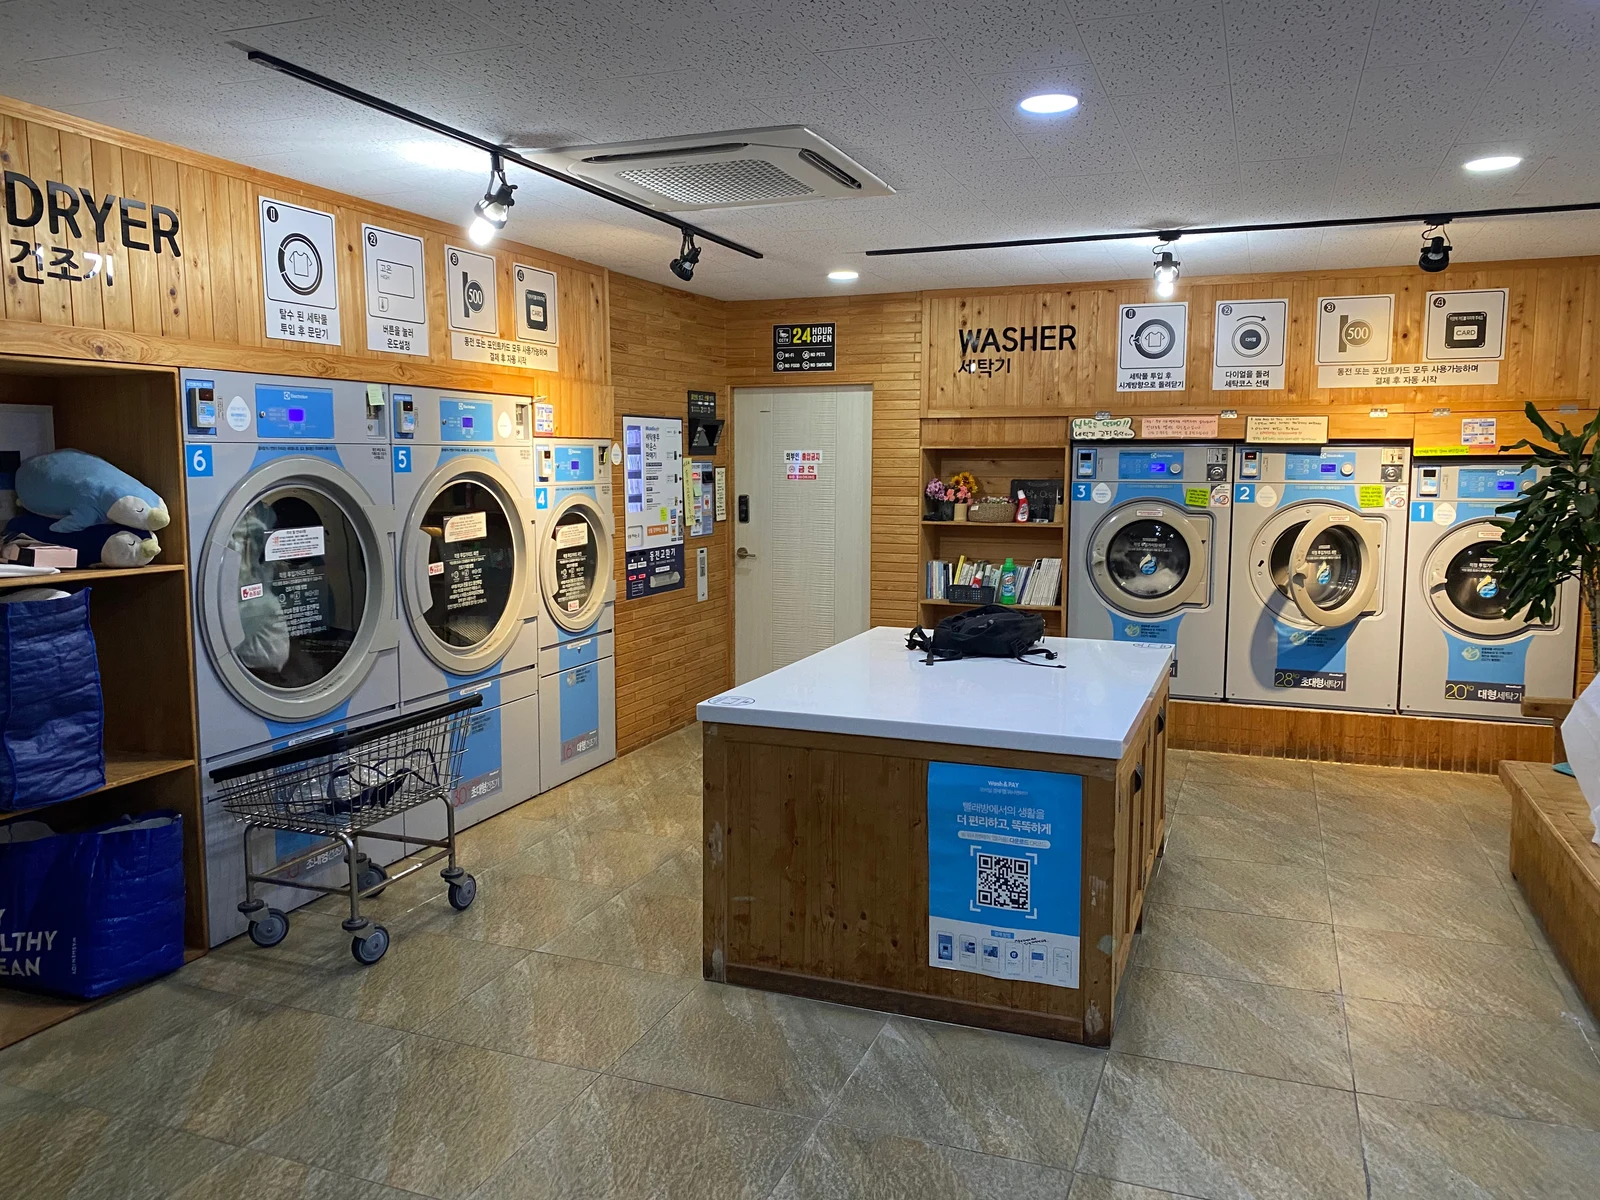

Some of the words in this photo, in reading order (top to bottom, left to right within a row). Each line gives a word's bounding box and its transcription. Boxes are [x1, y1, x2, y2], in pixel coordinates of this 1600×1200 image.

[4, 170, 181, 257] DRYER
[10, 239, 114, 287] 건조기
[468, 288, 483, 305] 500
[279, 308, 295, 322] 탈수
[296, 311, 304, 322] 된
[307, 313, 328, 326] 세탁물
[280, 323, 296, 336] 투입
[298, 325, 306, 336] 후
[308, 326, 329, 340] 문닫기
[382, 324, 400, 338] 버튼을
[792, 328, 812, 344] 24
[812, 326, 832, 335] HOUR
[1347, 326, 1369, 340] 500
[1456, 328, 1476, 337] CARD
[387, 338, 411, 351] 온도설정
[812, 335, 832, 343] OPEN
[958, 324, 1077, 357] WASHER
[958, 358, 1010, 378] 세탁기
[1226, 370, 1254, 378] 다이얼을
[1255, 370, 1270, 378] 돌려
[1336, 366, 1352, 376] 동전
[1354, 366, 1370, 376] 또는
[1372, 365, 1410, 376] 포인트카드
[1413, 364, 1428, 374] 모두
[1431, 364, 1479, 374] 사용가능하며
[1255, 380, 1270, 388] 선택
[1375, 376, 1390, 386] 결제
[1393, 376, 1401, 384] 후
[1403, 375, 1418, 384] 자동
[1421, 374, 1438, 384] 시작
[193, 449, 206, 472] 6
[398, 450, 407, 468] 5
[785, 452, 800, 461] 외부인
[802, 452, 820, 461] 출입금지
[538, 491, 545, 504] 4
[1077, 486, 1086, 498] 3
[1240, 486, 1250, 500] 2
[1419, 505, 1426, 518] 1
[649, 548, 676, 562] 동전교환기
[1300, 676, 1344, 689] 초대형세탁기
[1478, 689, 1522, 701] 대형세탁기
[576, 736, 598, 752] 대형건조기
[470, 778, 500, 799] 초대형건조기
[962, 802, 1016, 816] 빨래방에서의
[1018, 807, 1045, 820] 생활을
[956, 815, 967, 826] 더
[969, 815, 1010, 831] 편리하고,
[1012, 820, 1052, 836] 똑똑하게
[1009, 837, 1029, 846] 다운로드
